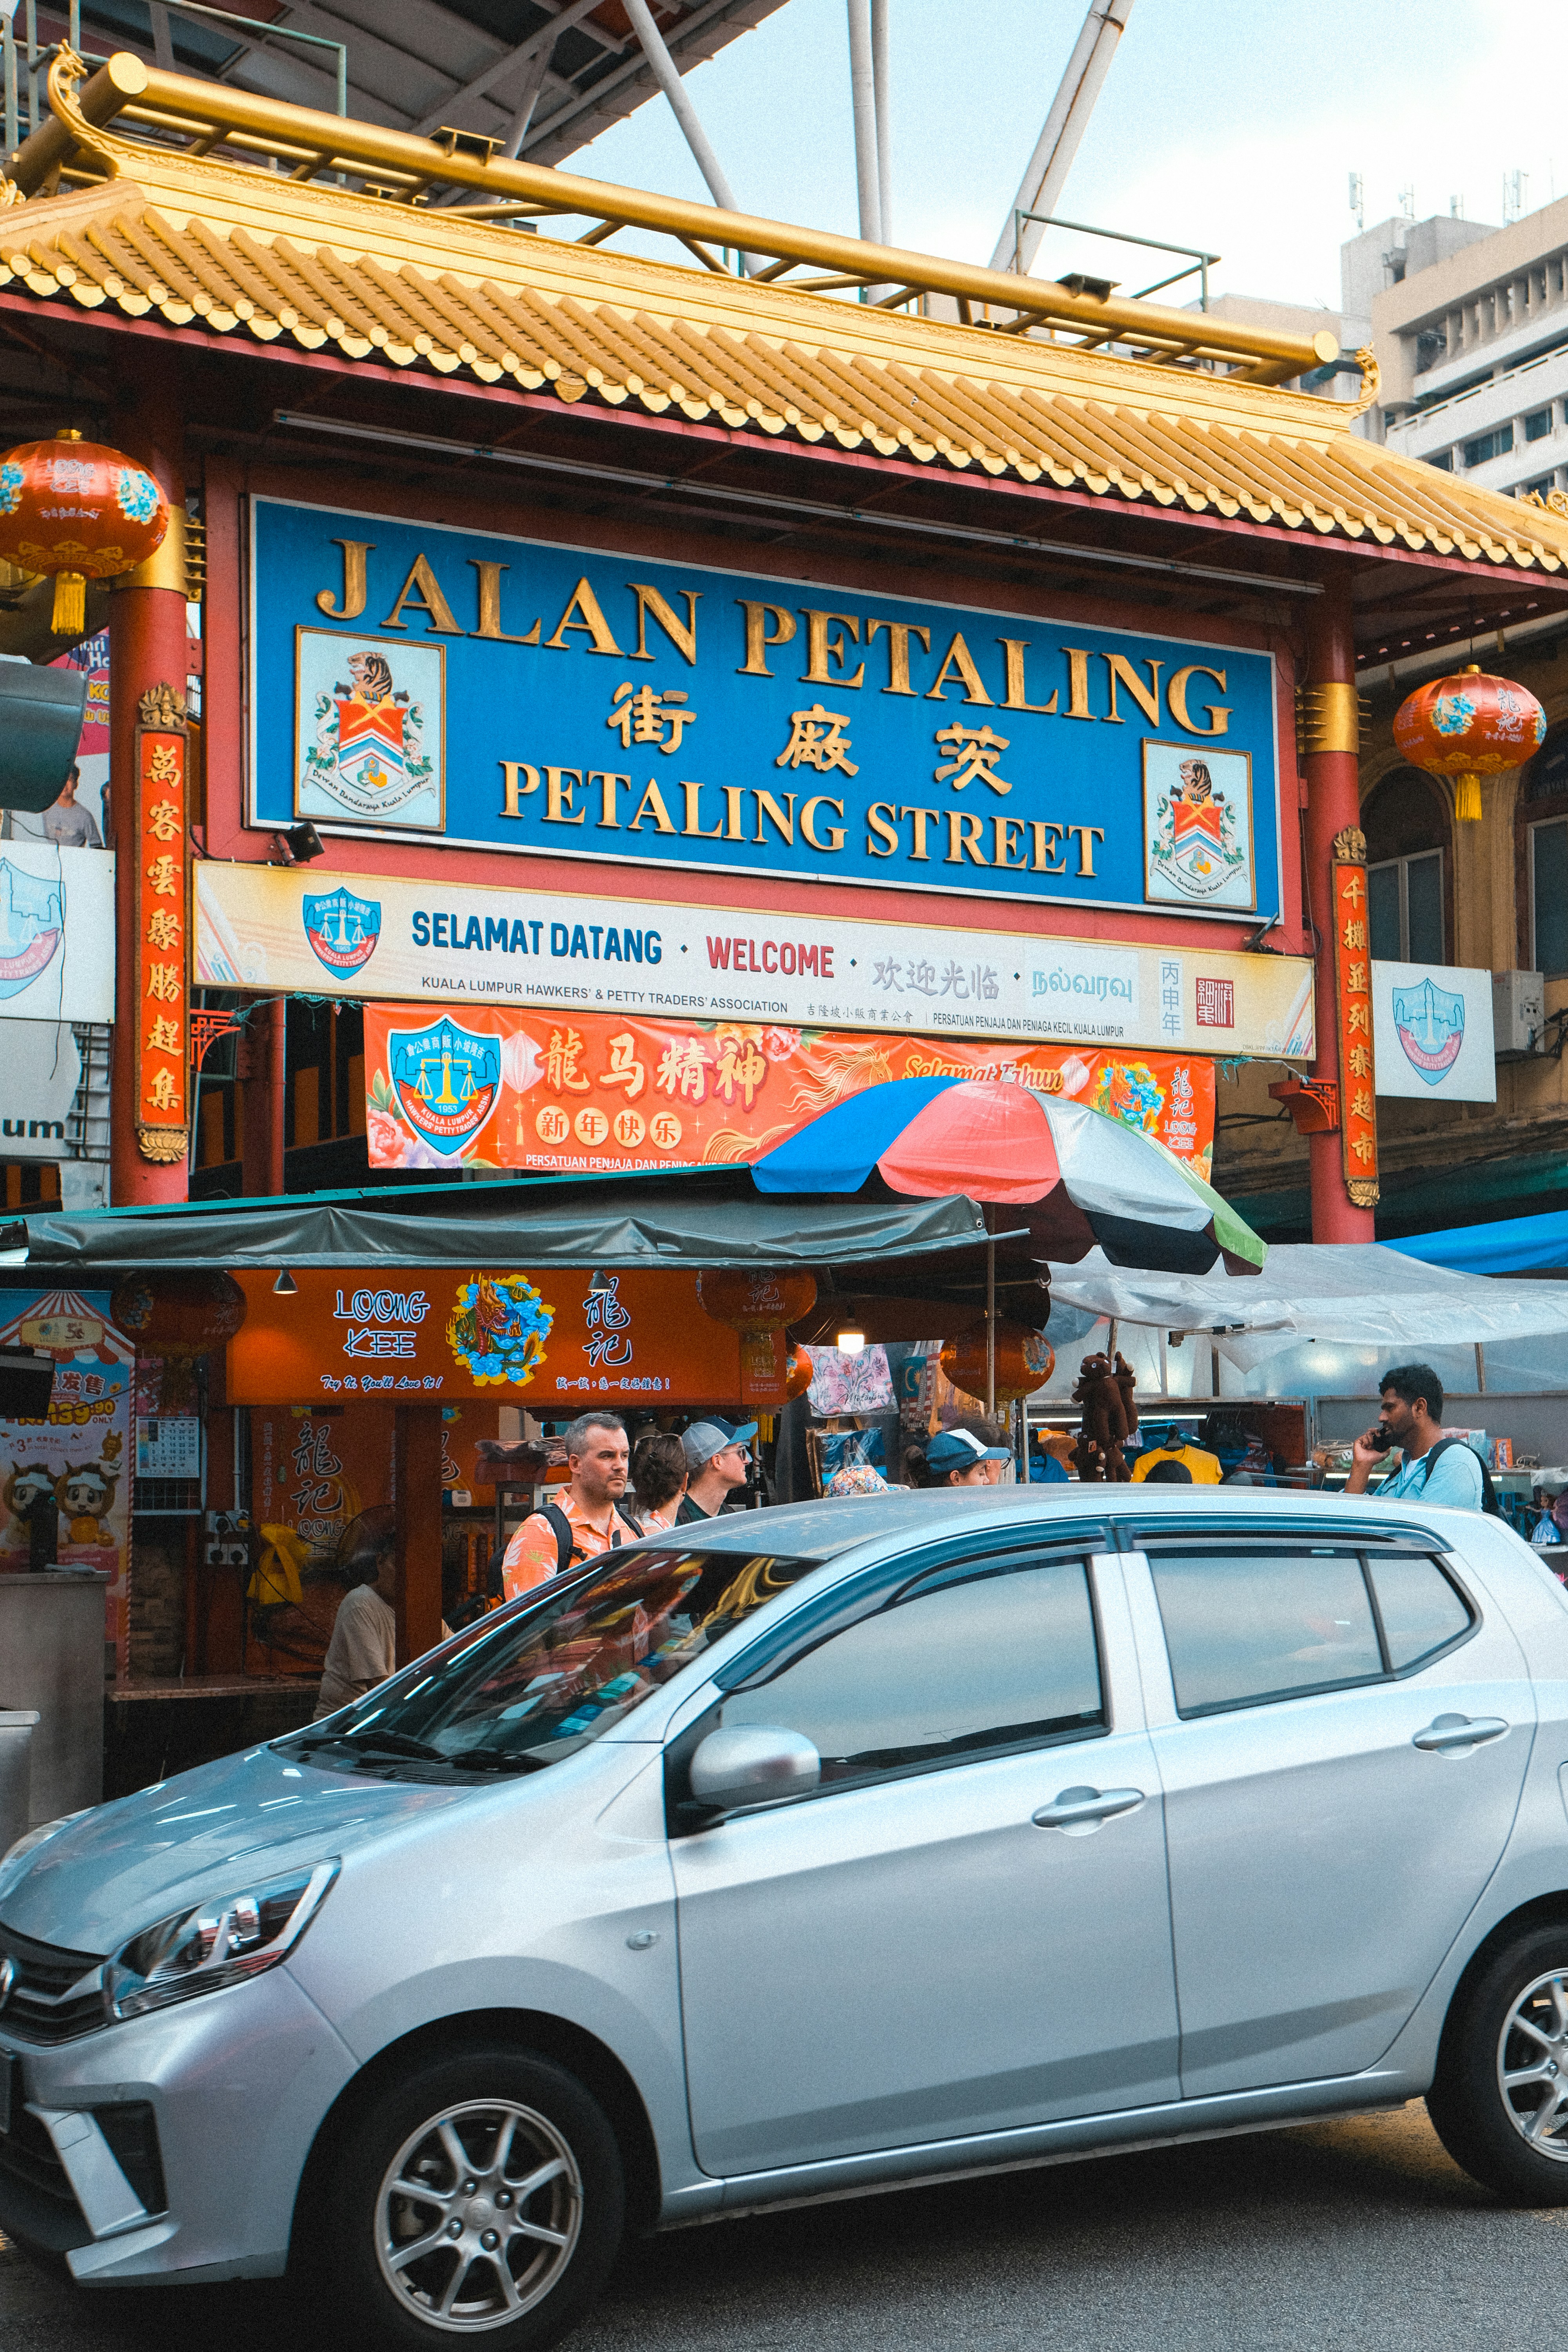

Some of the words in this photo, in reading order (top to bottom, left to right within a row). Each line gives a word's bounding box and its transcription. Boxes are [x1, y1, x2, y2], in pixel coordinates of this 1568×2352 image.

[316, 538, 704, 666] JALAN
[736, 599, 1234, 736] PETALING
[1495, 687, 1523, 733] 龍記
[313, 769, 339, 791] Dewan
[382, 796, 402, 808] Kuala
[402, 778, 429, 798] Lumpur
[499, 760, 849, 851] PETALING
[866, 802, 1104, 877] STREET
[1158, 860, 1176, 880] Dewan
[1223, 866, 1242, 884] Lumpur
[412, 911, 544, 955] SELAMAT
[551, 922, 662, 964] DATANG
[4, 953, 36, 969] LUMPUR
[706, 935, 834, 978] WELCOME
[872, 956, 1000, 1000] 欢迎光临
[1032, 967, 1132, 1003] நல்வரவு
[422, 976, 466, 990] KUALA
[470, 980, 522, 994] LUMPUR
[526, 984, 591, 999] HAWKERS'
[595, 989, 603, 999] &
[607, 990, 645, 1003] PETTY
[648, 993, 708, 1007] TRADERS'
[710, 997, 788, 1013] ASSOCIATION
[1161, 961, 1181, 1037] 丙申年
[806, 1002, 914, 1024] 吉隆坡小販商業公會
[933, 1013, 974, 1027] PERSATUAN
[975, 1016, 1006, 1029] PENJAJA
[1007, 1018, 1021, 1030] DAN
[1023, 1020, 1052, 1032] PENIAGA
[1053, 1022, 1073, 1034] KECIL
[1074, 1023, 1096, 1036] KUALA
[1097, 1025, 1124, 1037] LUMPUR
[538, 1027, 766, 1106] 龍马精神
[903, 1054, 998, 1080] Selamat
[1170, 1067, 1193, 1117] 龍記
[421, 1107, 445, 1125] KUALA
[447, 1108, 474, 1127] LUMPUR
[438, 1105, 457, 1114] 1953
[2, 1118, 64, 1139] um
[434, 1125, 454, 1135] PETTY
[542, 1112, 676, 1143] 新年快乐
[1164, 1120, 1197, 1135] LOONG
[1168, 1136, 1194, 1149] KEE
[526, 1154, 587, 1168] PERSATUAN
[590, 1157, 633, 1169] PENJAJA
[635, 1159, 657, 1170] DAN
[333, 1290, 430, 1323] LOONG
[583, 1276, 633, 1368] 龍記
[343, 1328, 416, 1358] KEE
[320, 1375, 342, 1392] Try
[361, 1376, 394, 1392] You'll
[394, 1376, 421, 1390] Love
[290, 1421, 343, 1515] 龍記
[289, 1518, 347, 1539] OONG
